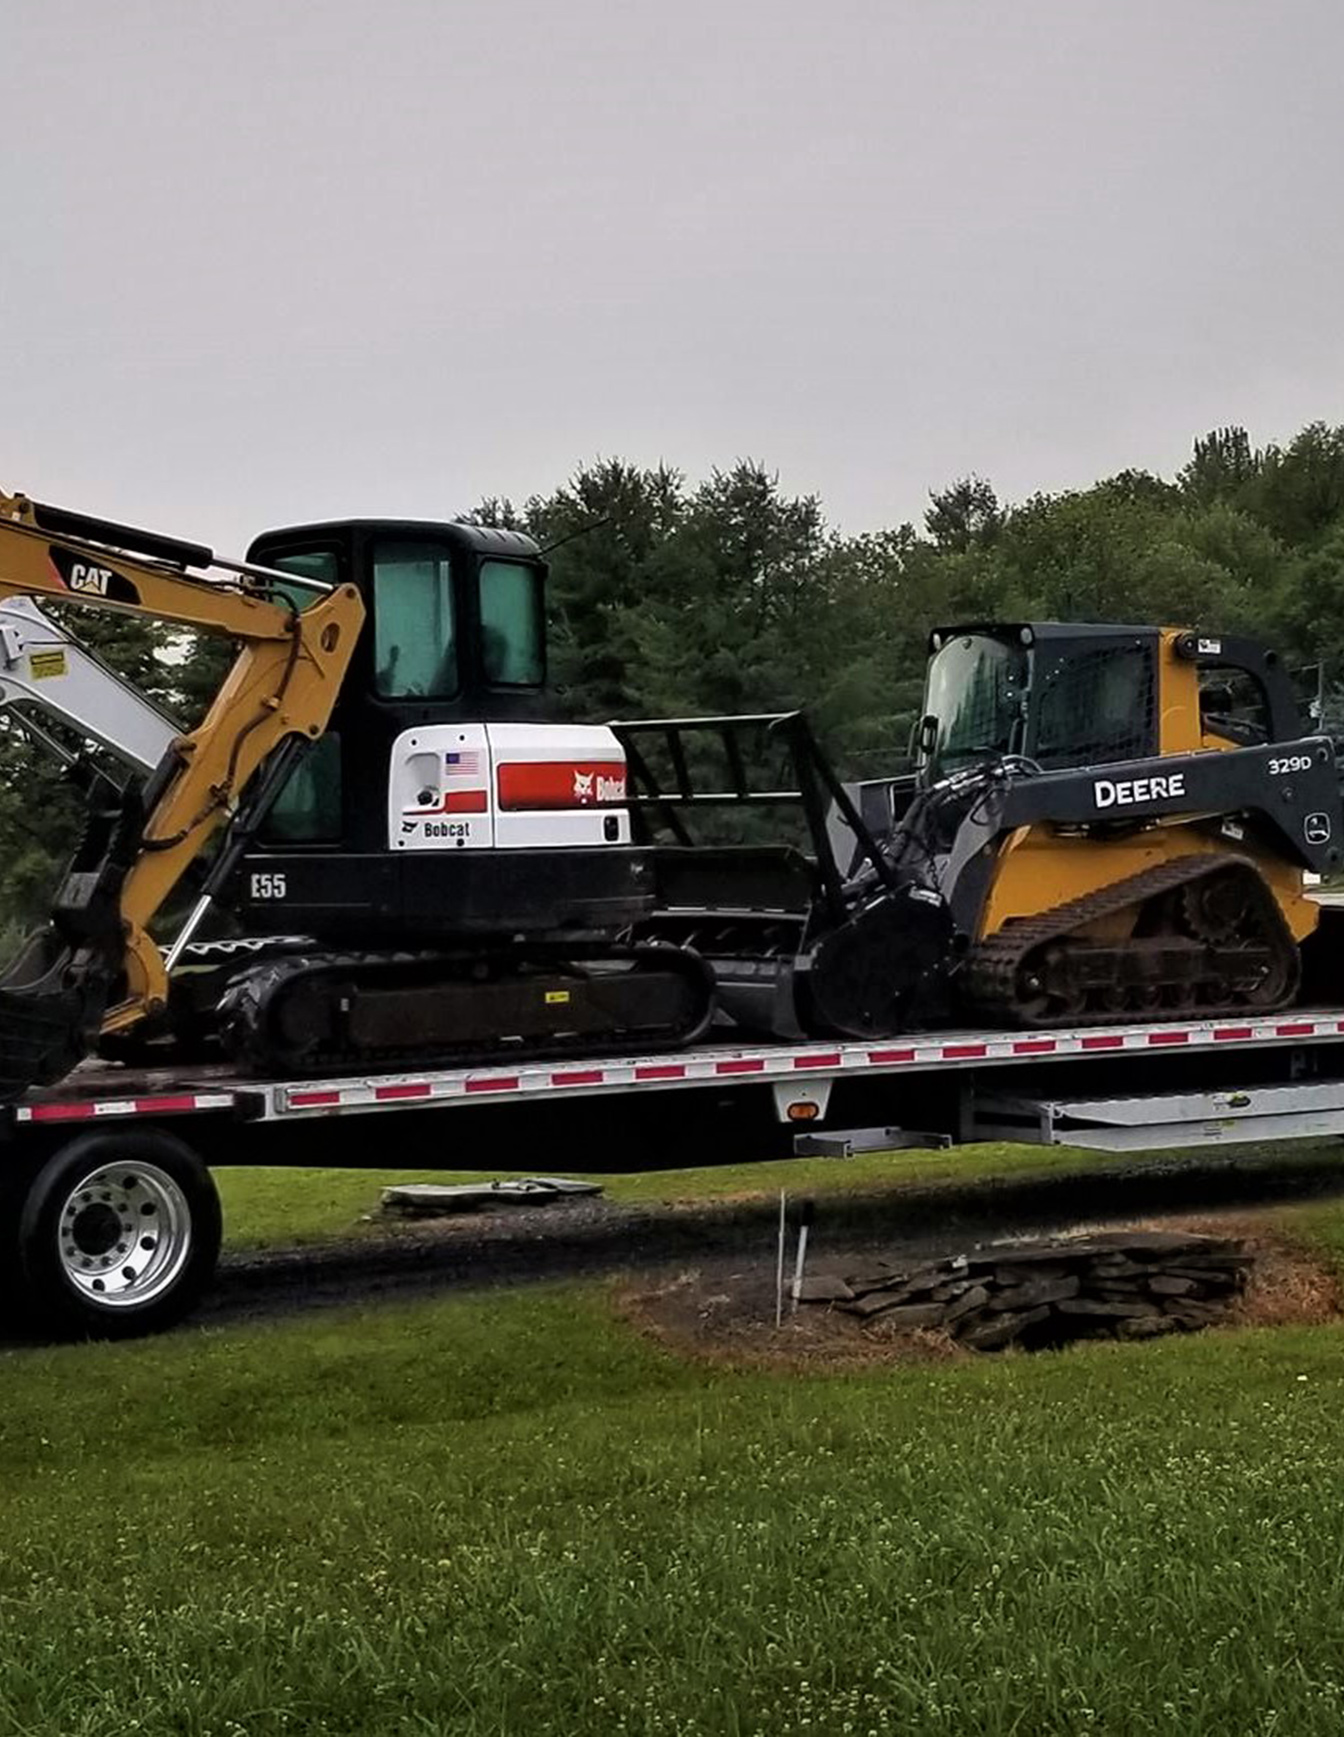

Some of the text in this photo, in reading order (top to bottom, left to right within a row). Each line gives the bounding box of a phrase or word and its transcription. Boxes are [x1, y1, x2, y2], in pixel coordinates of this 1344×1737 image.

[70, 563, 113, 596] CAT
[1268, 756, 1312, 775] 329D
[1094, 773, 1186, 808] DEERE
[424, 821, 470, 838] Bobcat
[251, 873, 286, 898] E55
